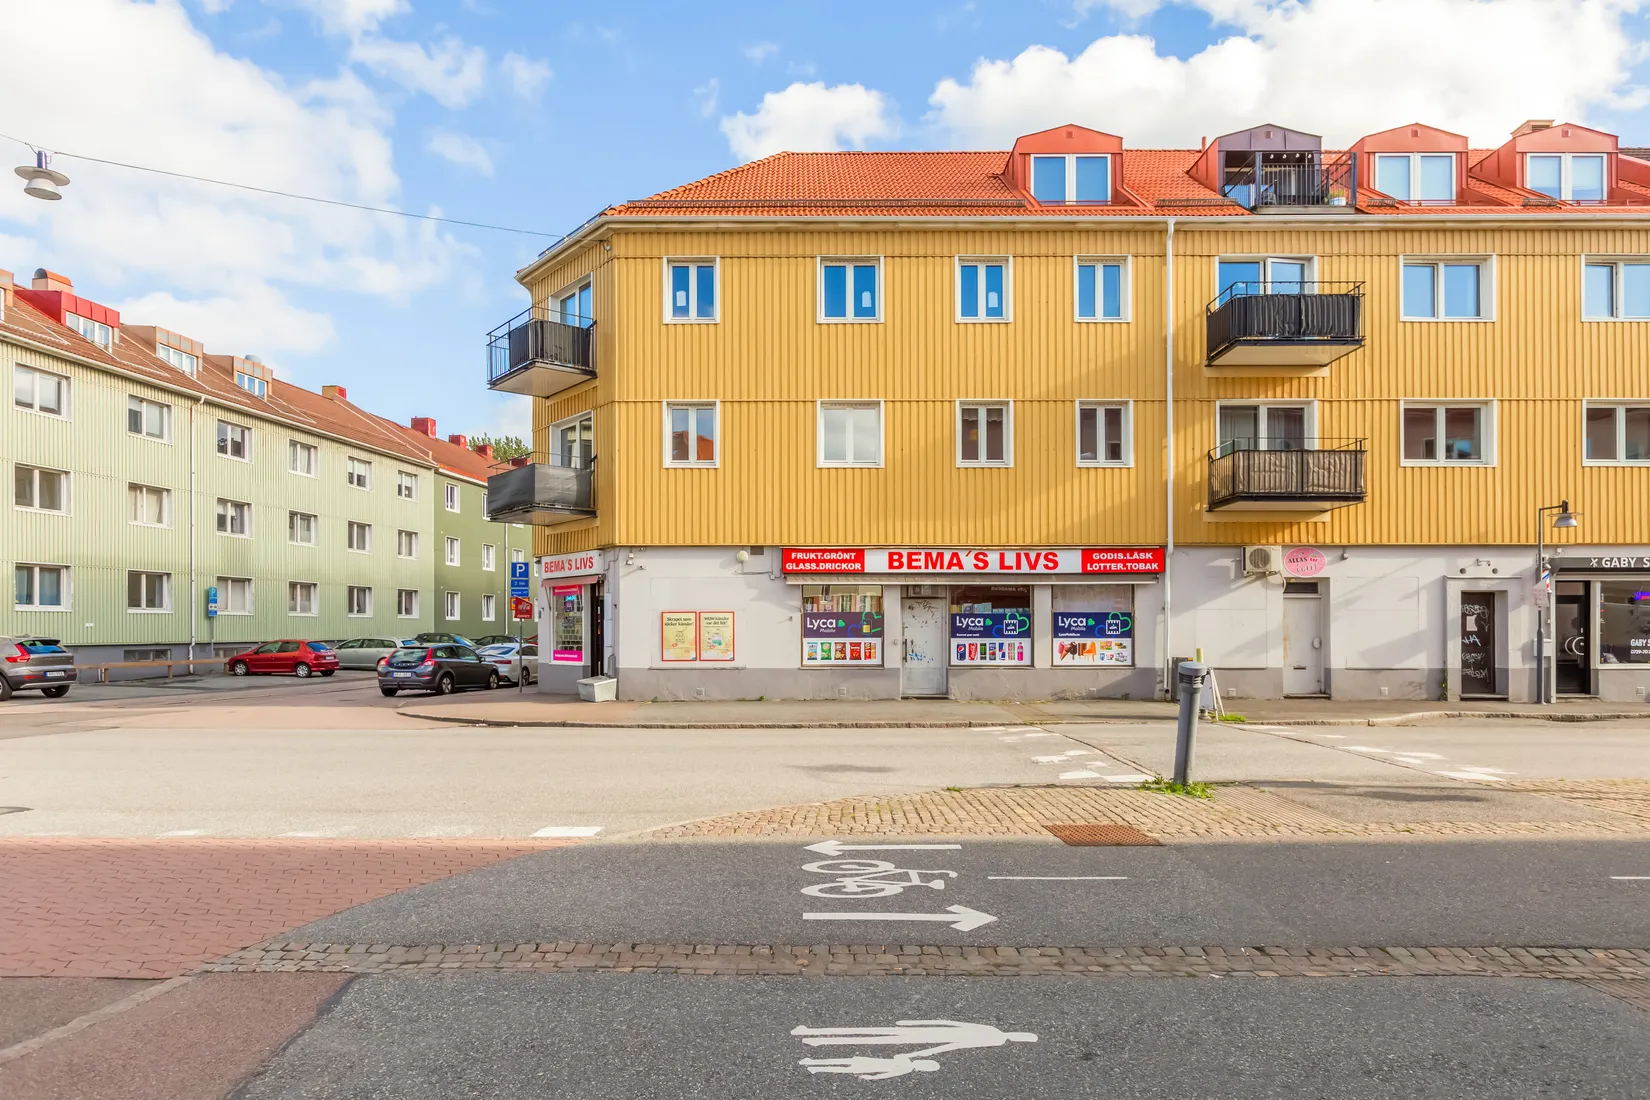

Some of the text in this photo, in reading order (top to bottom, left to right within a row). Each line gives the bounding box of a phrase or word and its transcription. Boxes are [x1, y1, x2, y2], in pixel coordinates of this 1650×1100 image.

[791, 551, 857, 561] FRUKT.GRÖNT
[998, 551, 1059, 571] LIVS
[1092, 551, 1154, 561] GODIS.LÄSK
[575, 555, 595, 571] LIVS
[785, 562, 862, 572] GLASS.DRICKOR
[1087, 562, 1160, 572] LOTTER.TOBAK
[1602, 557, 1637, 568] GABY
[516, 563, 526, 577] P
[806, 617, 836, 631] Lyca
[956, 615, 985, 629] Lyca
[1058, 615, 1087, 629] Lyca
[1630, 638, 1647, 647] GABY
